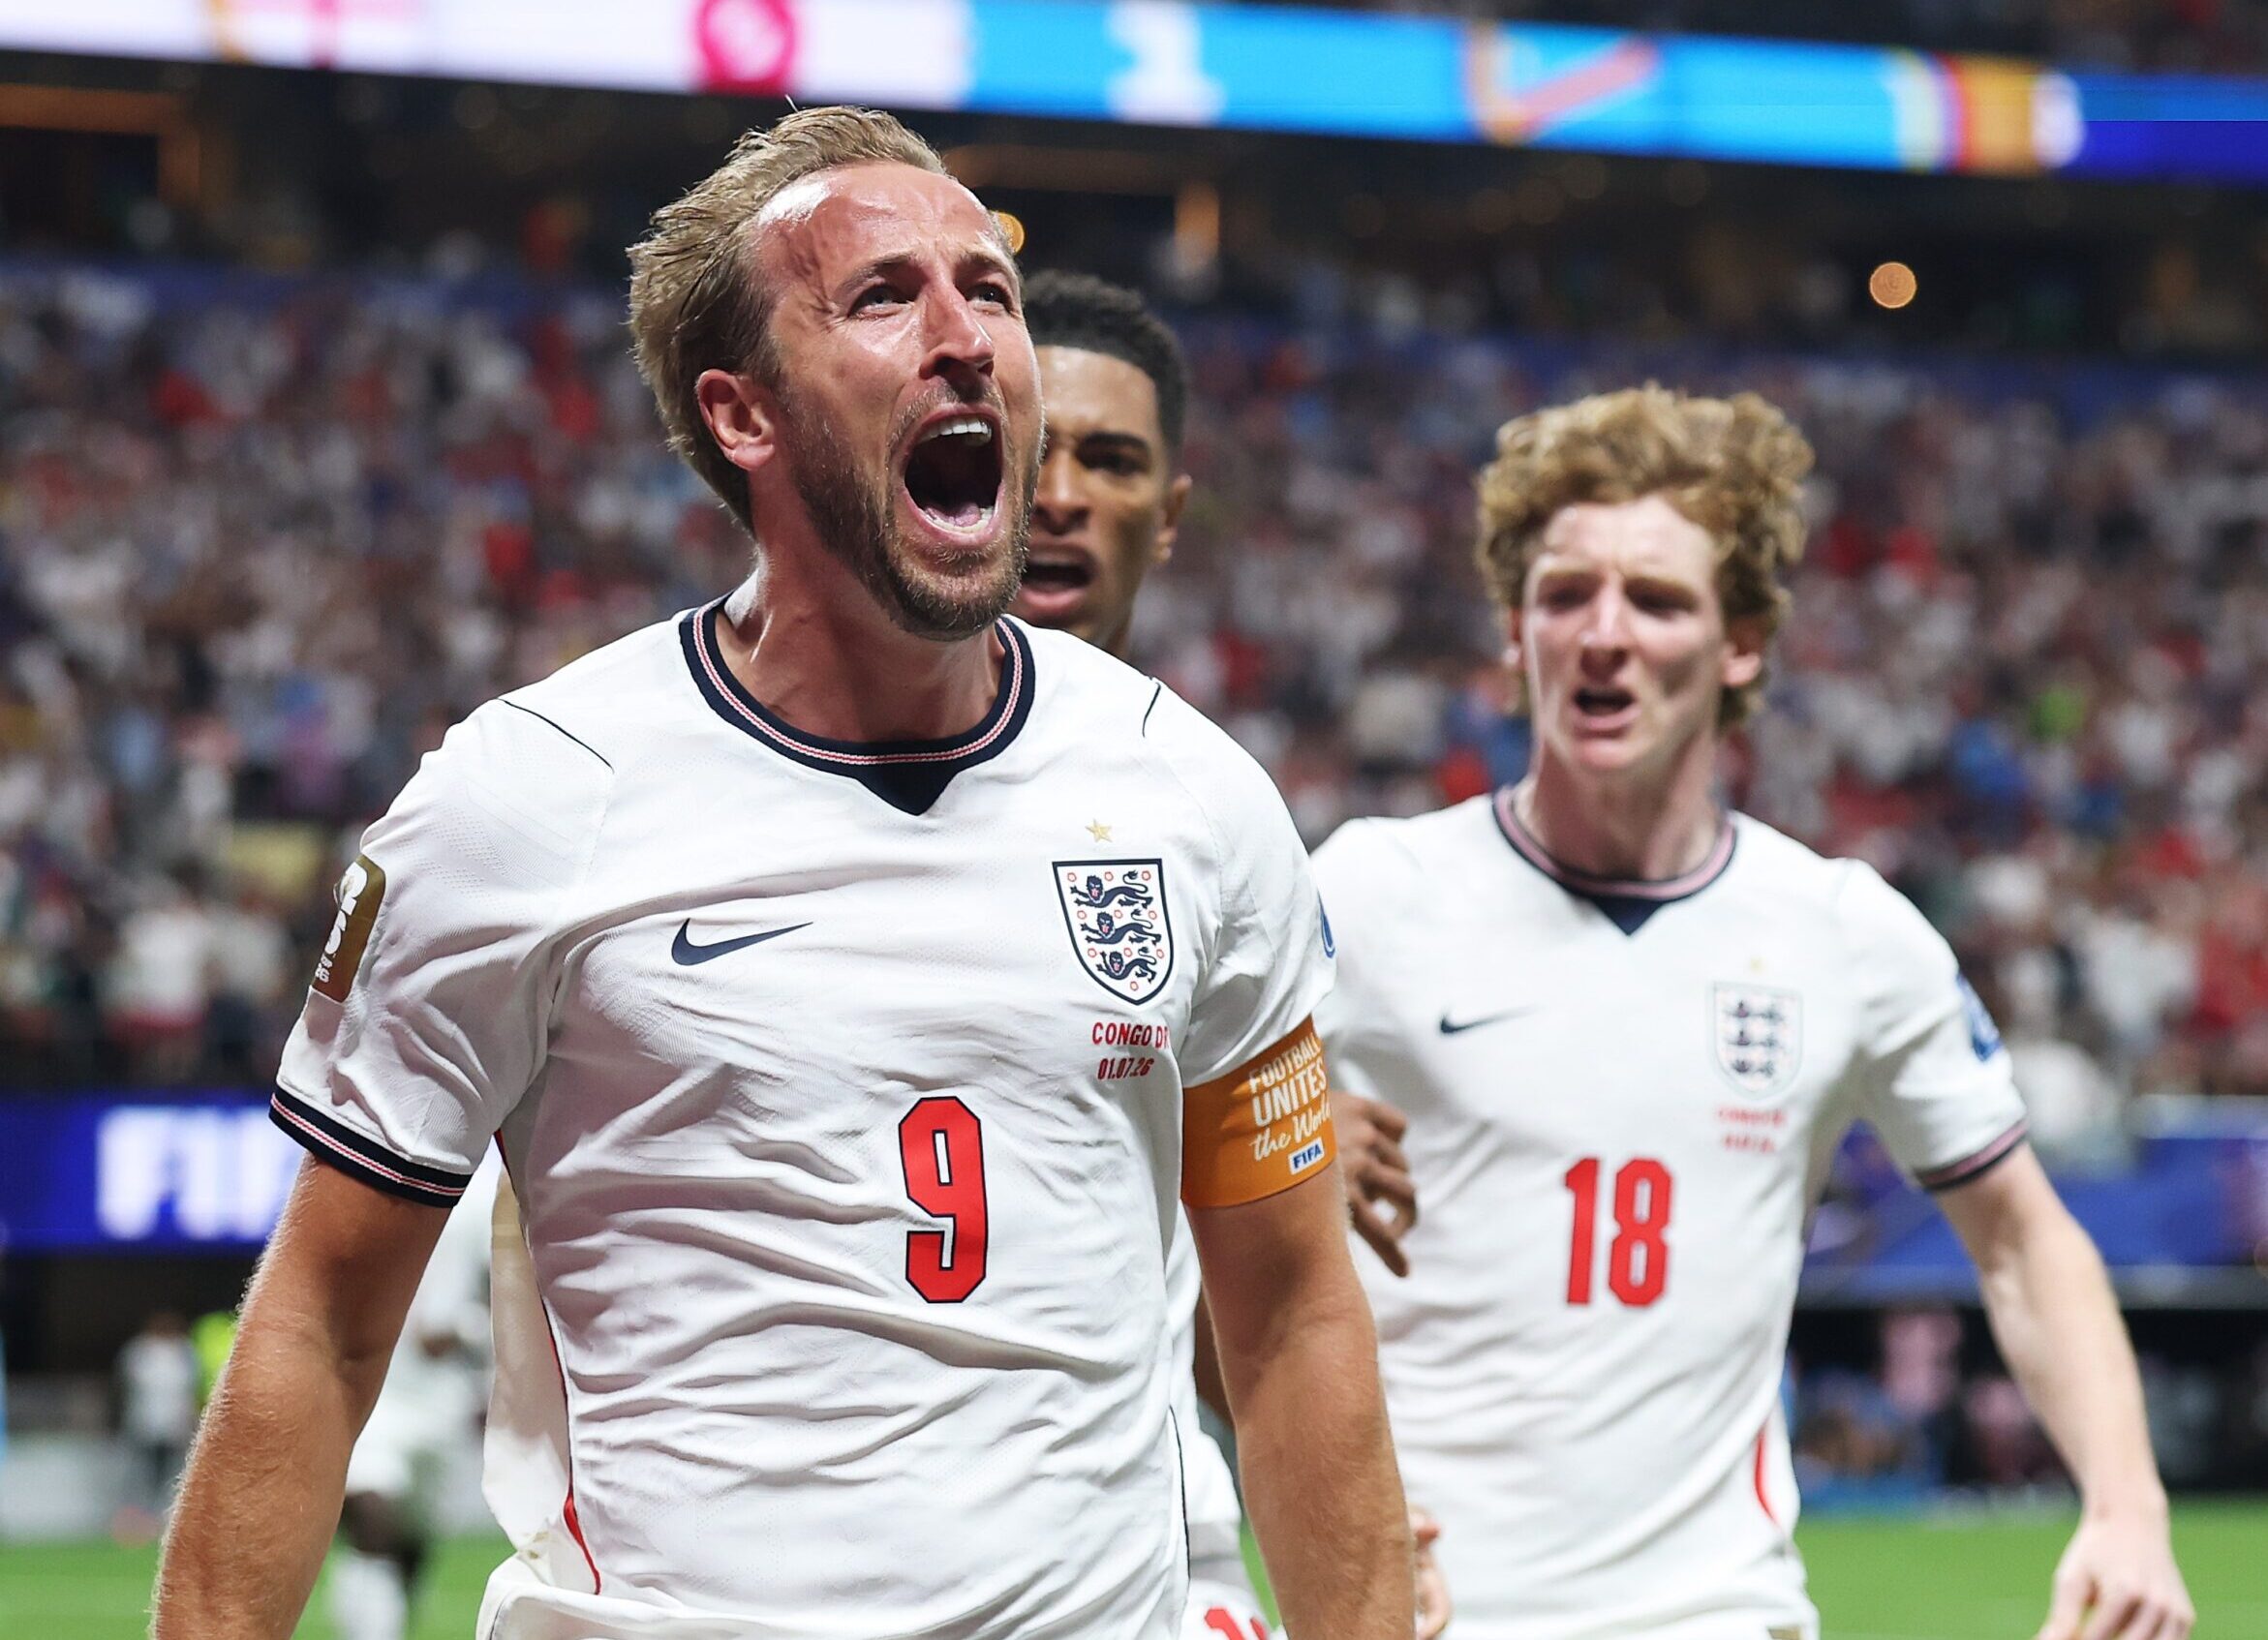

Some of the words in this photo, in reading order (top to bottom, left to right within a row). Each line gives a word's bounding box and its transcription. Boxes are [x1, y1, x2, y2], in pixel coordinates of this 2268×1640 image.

[1092, 1021, 1153, 1047] CONGO
[1097, 1057, 1154, 1080] 01.07.26
[1249, 1032, 1322, 1094] FOOTBALL
[1253, 1056, 1327, 1127] UNITES
[1249, 1127, 1292, 1161] the
[1293, 1143, 1323, 1169] FIFA
[898, 1096, 989, 1303] 9
[1563, 1156, 1673, 1309] 18
